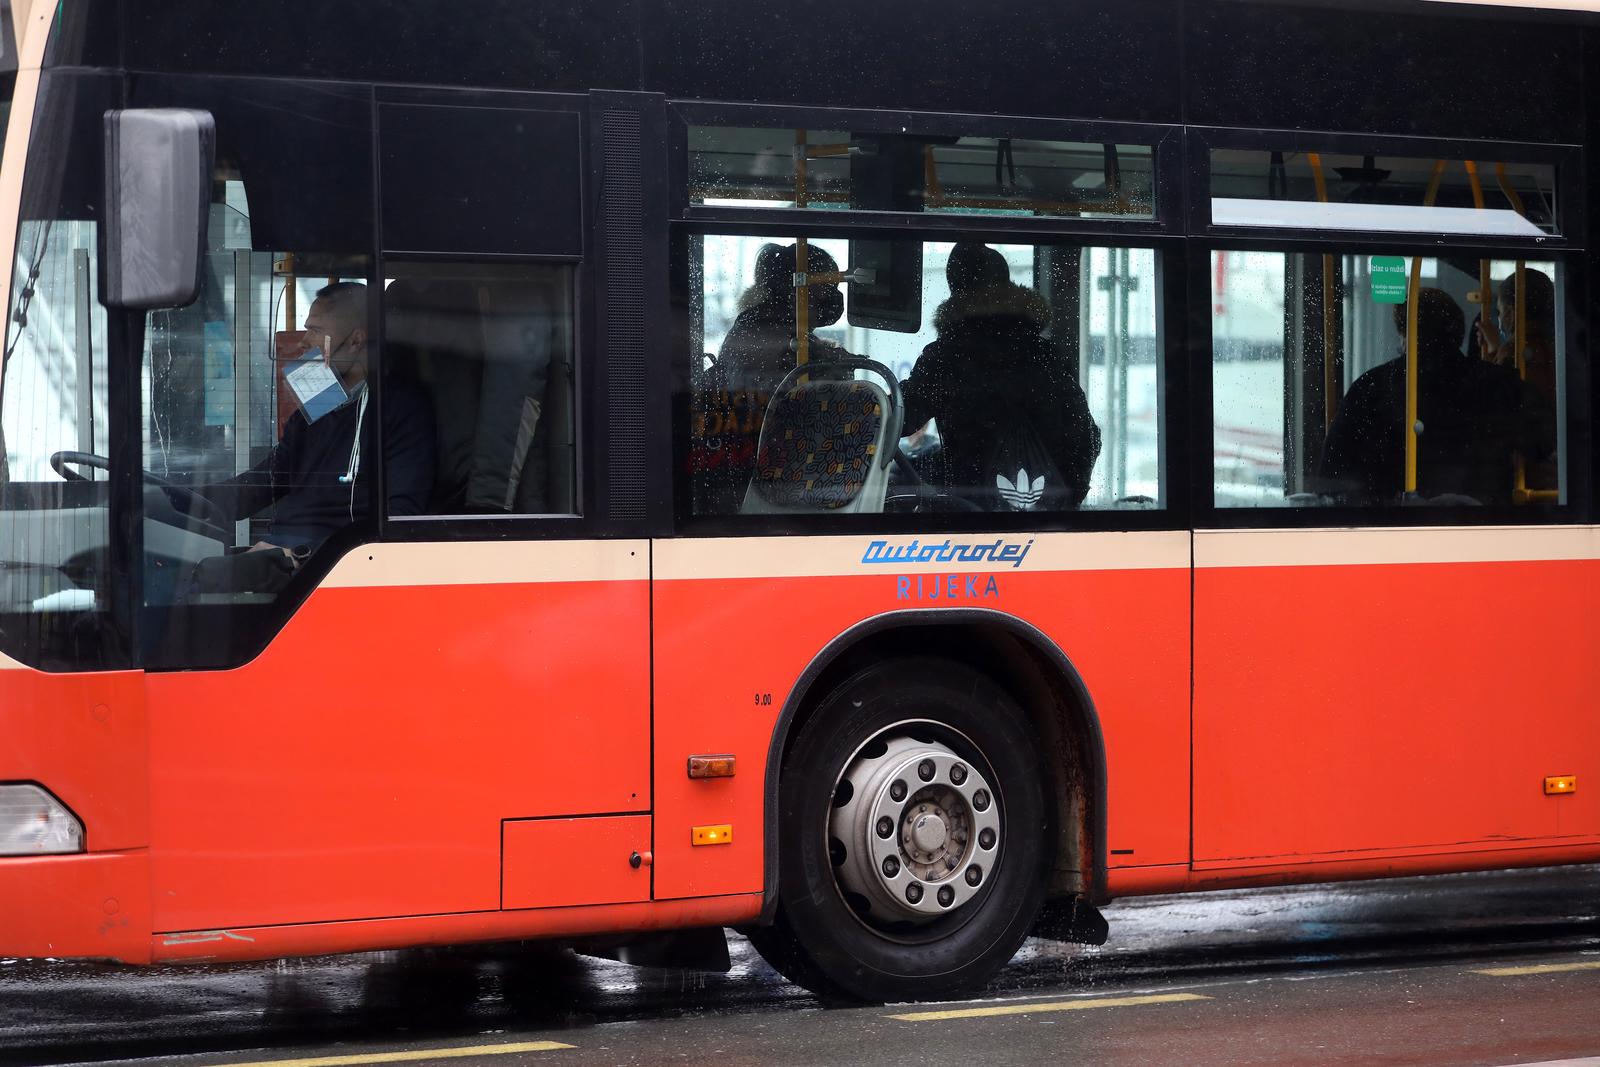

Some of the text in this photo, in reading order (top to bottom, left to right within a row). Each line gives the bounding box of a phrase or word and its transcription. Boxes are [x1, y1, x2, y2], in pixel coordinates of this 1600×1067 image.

[1371, 264, 1384, 272] Izlaz
[896, 575, 999, 600] RIJEKA
[755, 693, 772, 706] 9.00
